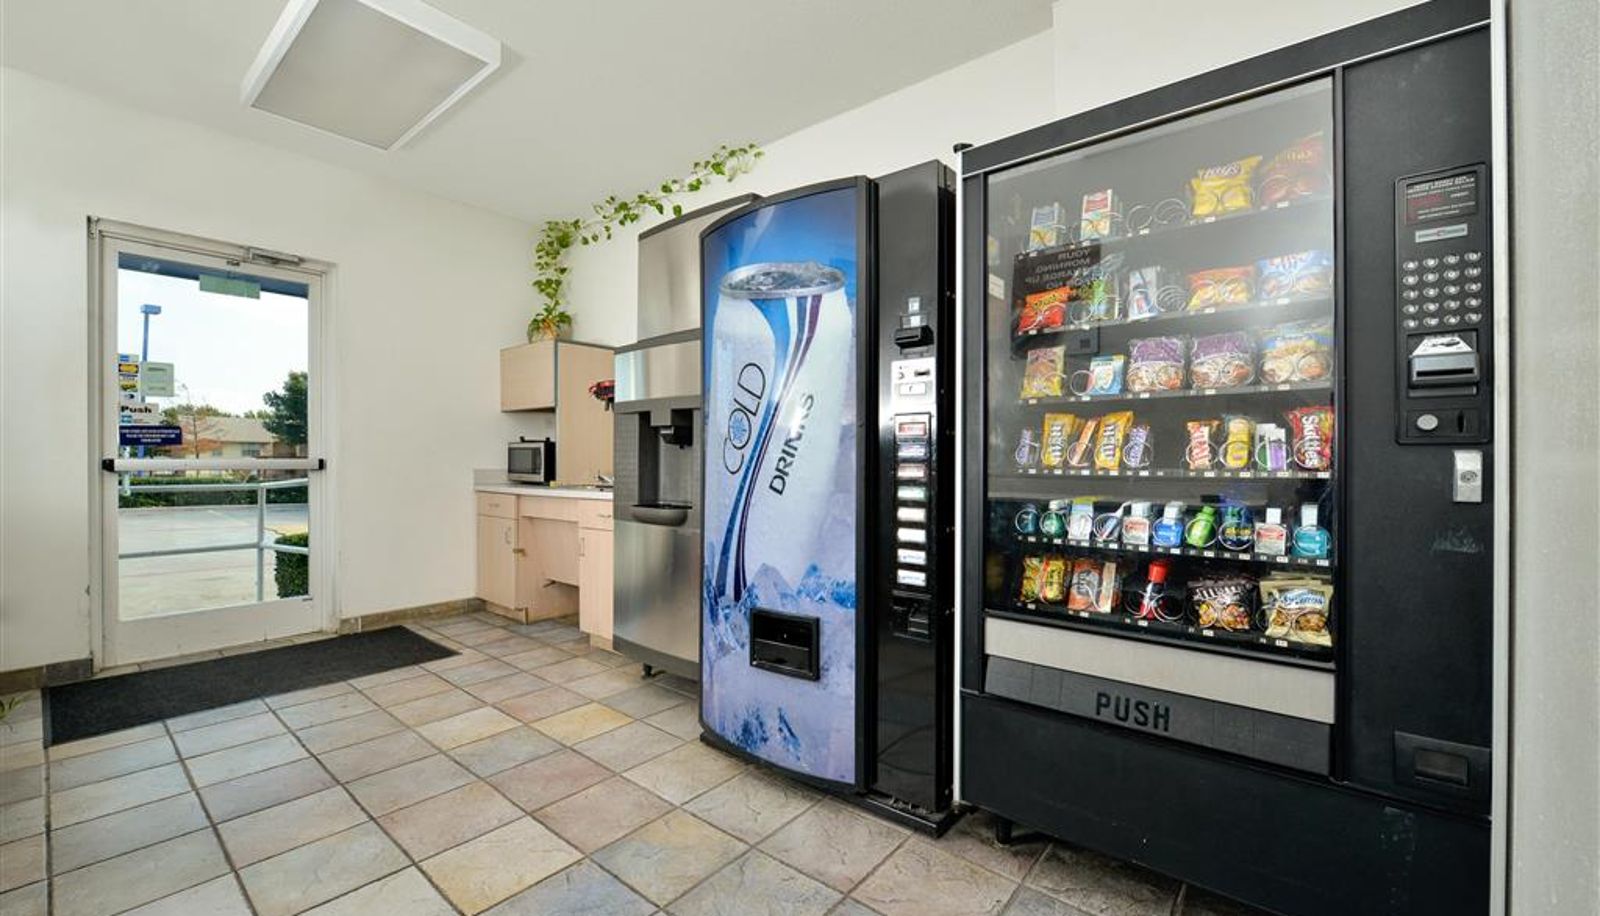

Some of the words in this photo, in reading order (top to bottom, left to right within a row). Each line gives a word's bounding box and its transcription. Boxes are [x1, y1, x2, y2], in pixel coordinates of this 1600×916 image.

[120, 405, 152, 414] Push
[723, 362, 766, 475] COLD
[769, 393, 815, 496] DRINS
[1301, 415, 1321, 467] Skittles
[1096, 692, 1170, 732] PUSH
